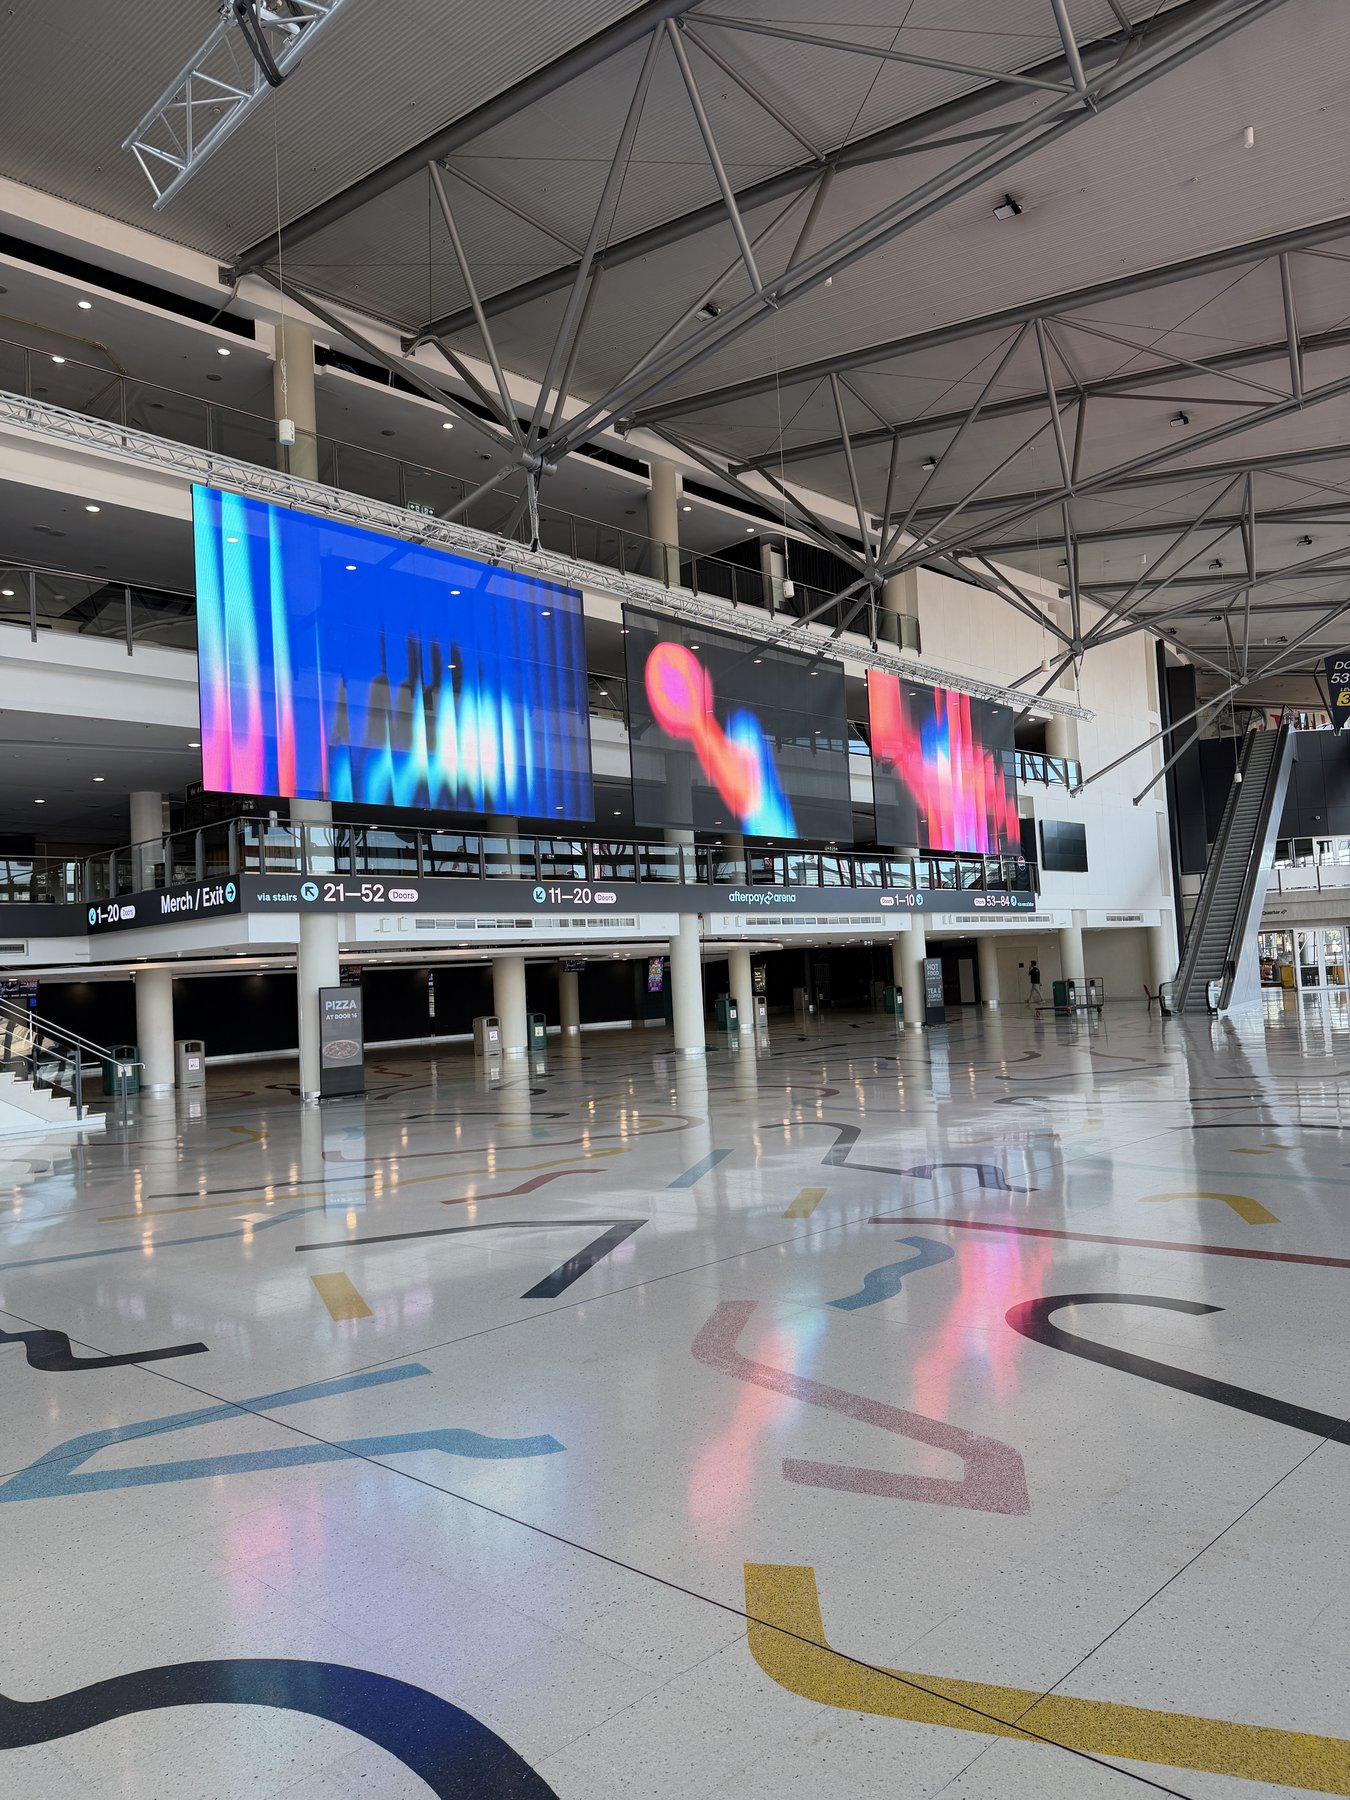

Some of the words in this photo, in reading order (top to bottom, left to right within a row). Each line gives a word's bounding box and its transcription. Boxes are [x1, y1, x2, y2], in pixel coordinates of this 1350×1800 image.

[161, 891, 193, 914] Merch
[195, 889, 200, 911] /
[203, 885, 225, 907] Exit
[257, 893, 271, 902] via
[272, 893, 298, 902] stairs
[323, 883, 385, 903] 21–52
[392, 891, 415, 900] Doors
[548, 887, 592, 904] 11–20
[729, 891, 765, 905] afterpay
[773, 894, 797, 903] arena
[894, 893, 915, 906] 1–10
[986, 895, 1011, 907] 53–84
[97, 904, 119, 924] 1–20
[926, 963, 939, 971] HOT
[325, 1000, 358, 1010] PIZZA
